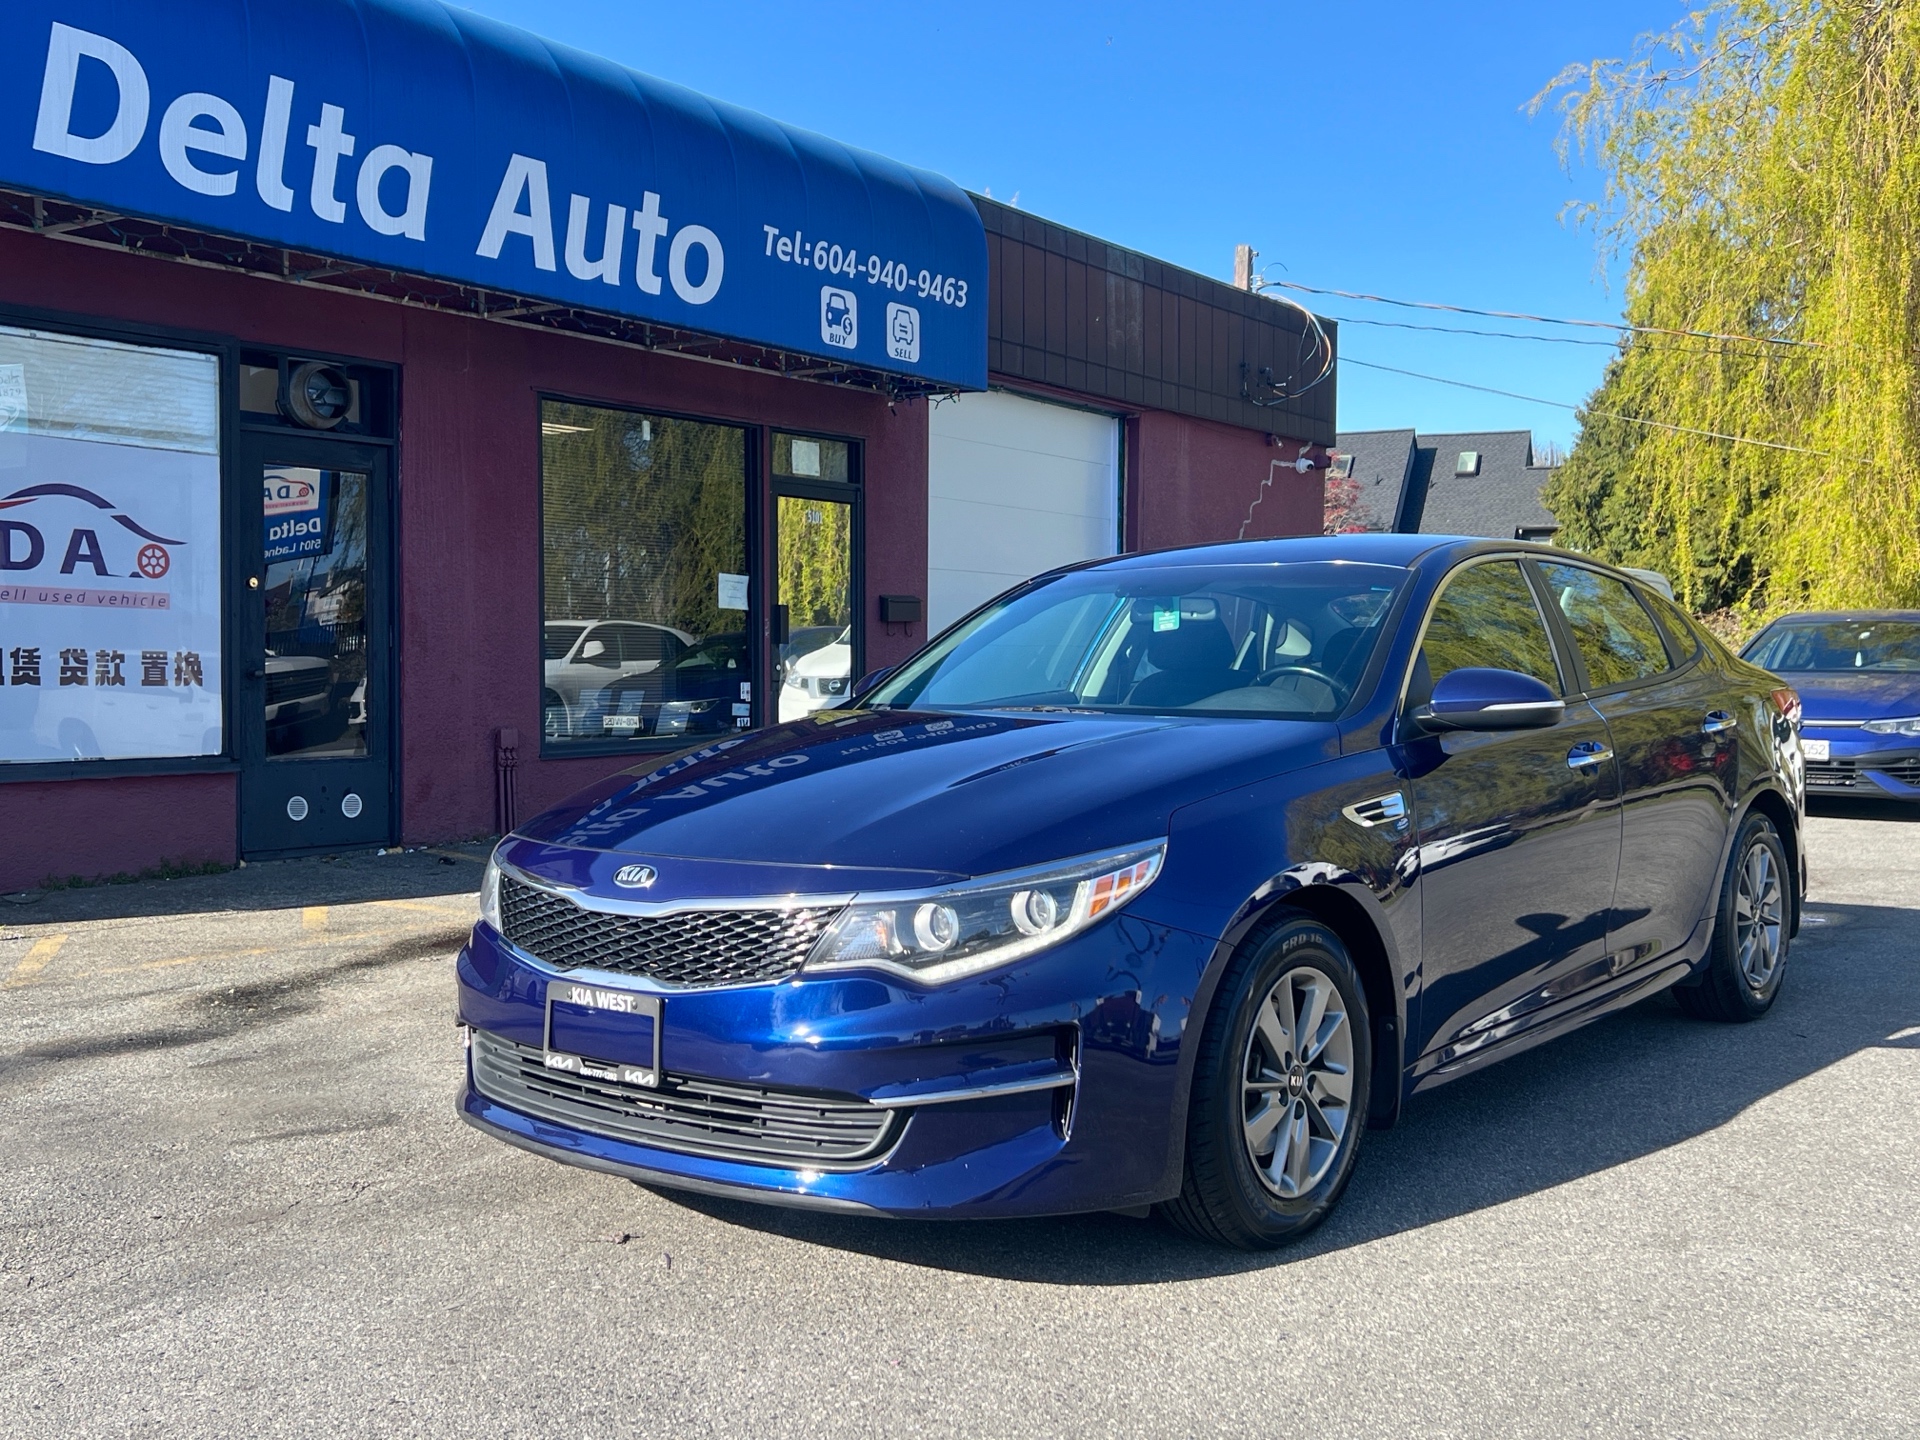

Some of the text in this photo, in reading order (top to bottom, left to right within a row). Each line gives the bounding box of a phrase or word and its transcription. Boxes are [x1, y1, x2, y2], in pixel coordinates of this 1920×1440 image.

[33, 21, 725, 305] Delta Auto
[763, 224, 968, 308] Tel:604-940-9463
[829, 333, 848, 345] BUY
[894, 347, 912, 360] SELL
[38, 591, 86, 603] used
[97, 594, 168, 608] vehicle
[0, 647, 204, 687] 赁 贷款 置换
[616, 866, 651, 883] KIA
[571, 986, 634, 1013] KIA WEST
